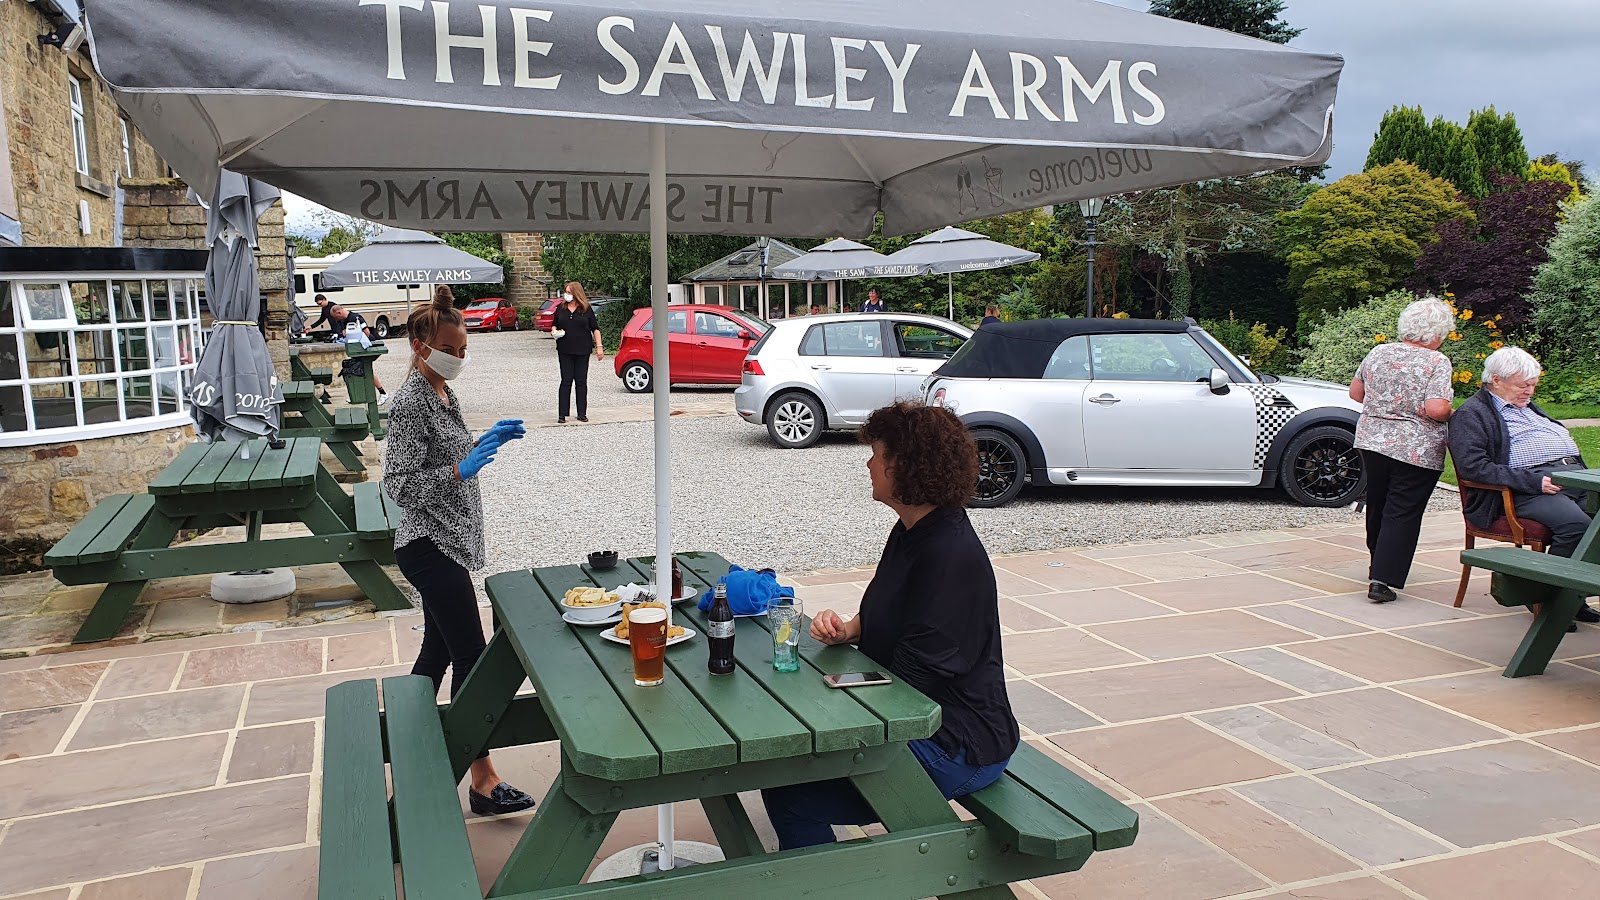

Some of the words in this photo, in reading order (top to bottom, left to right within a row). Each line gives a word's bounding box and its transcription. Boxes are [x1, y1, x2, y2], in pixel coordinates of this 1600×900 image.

[359, 0, 562, 90] THE
[596, 16, 921, 113] SAWLEY
[949, 48, 1165, 126] ARMS
[353, 271, 379, 283] THE
[383, 270, 432, 282] SAWLEY
[436, 269, 472, 281] ARMS
[834, 269, 848, 278] THE
[849, 268, 867, 278] SAW
[874, 265, 884, 275] THE
[884, 265, 903, 275] SAWLEY
[904, 265, 918, 274] ARMS
